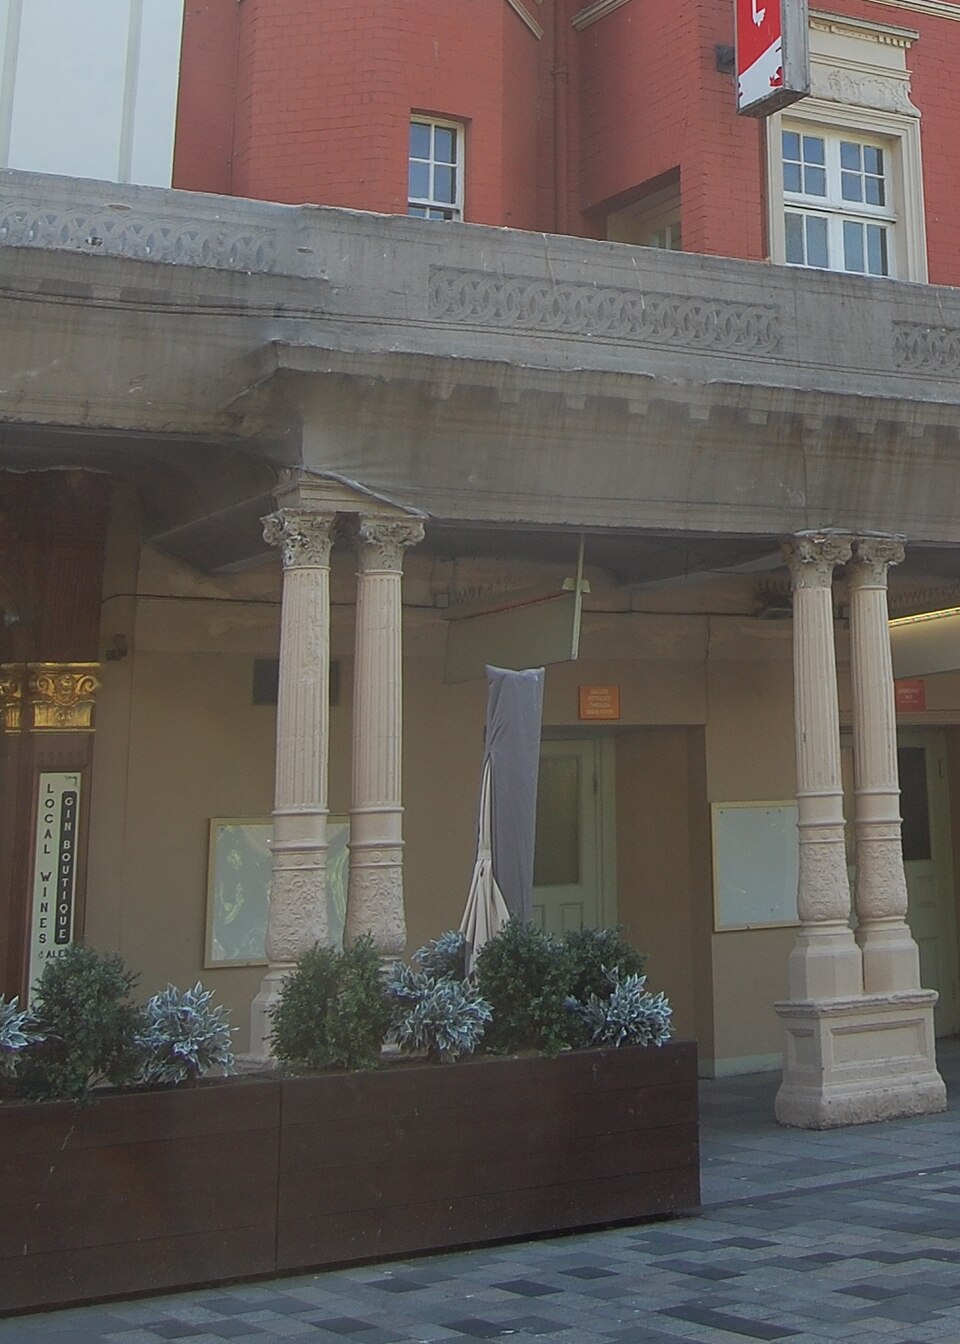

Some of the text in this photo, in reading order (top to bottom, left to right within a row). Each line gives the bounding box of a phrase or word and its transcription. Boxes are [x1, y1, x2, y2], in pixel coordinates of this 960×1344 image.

[39, 783, 55, 943] LOCAL WINES
[59, 797, 74, 939] GIN BOUTIQUE
